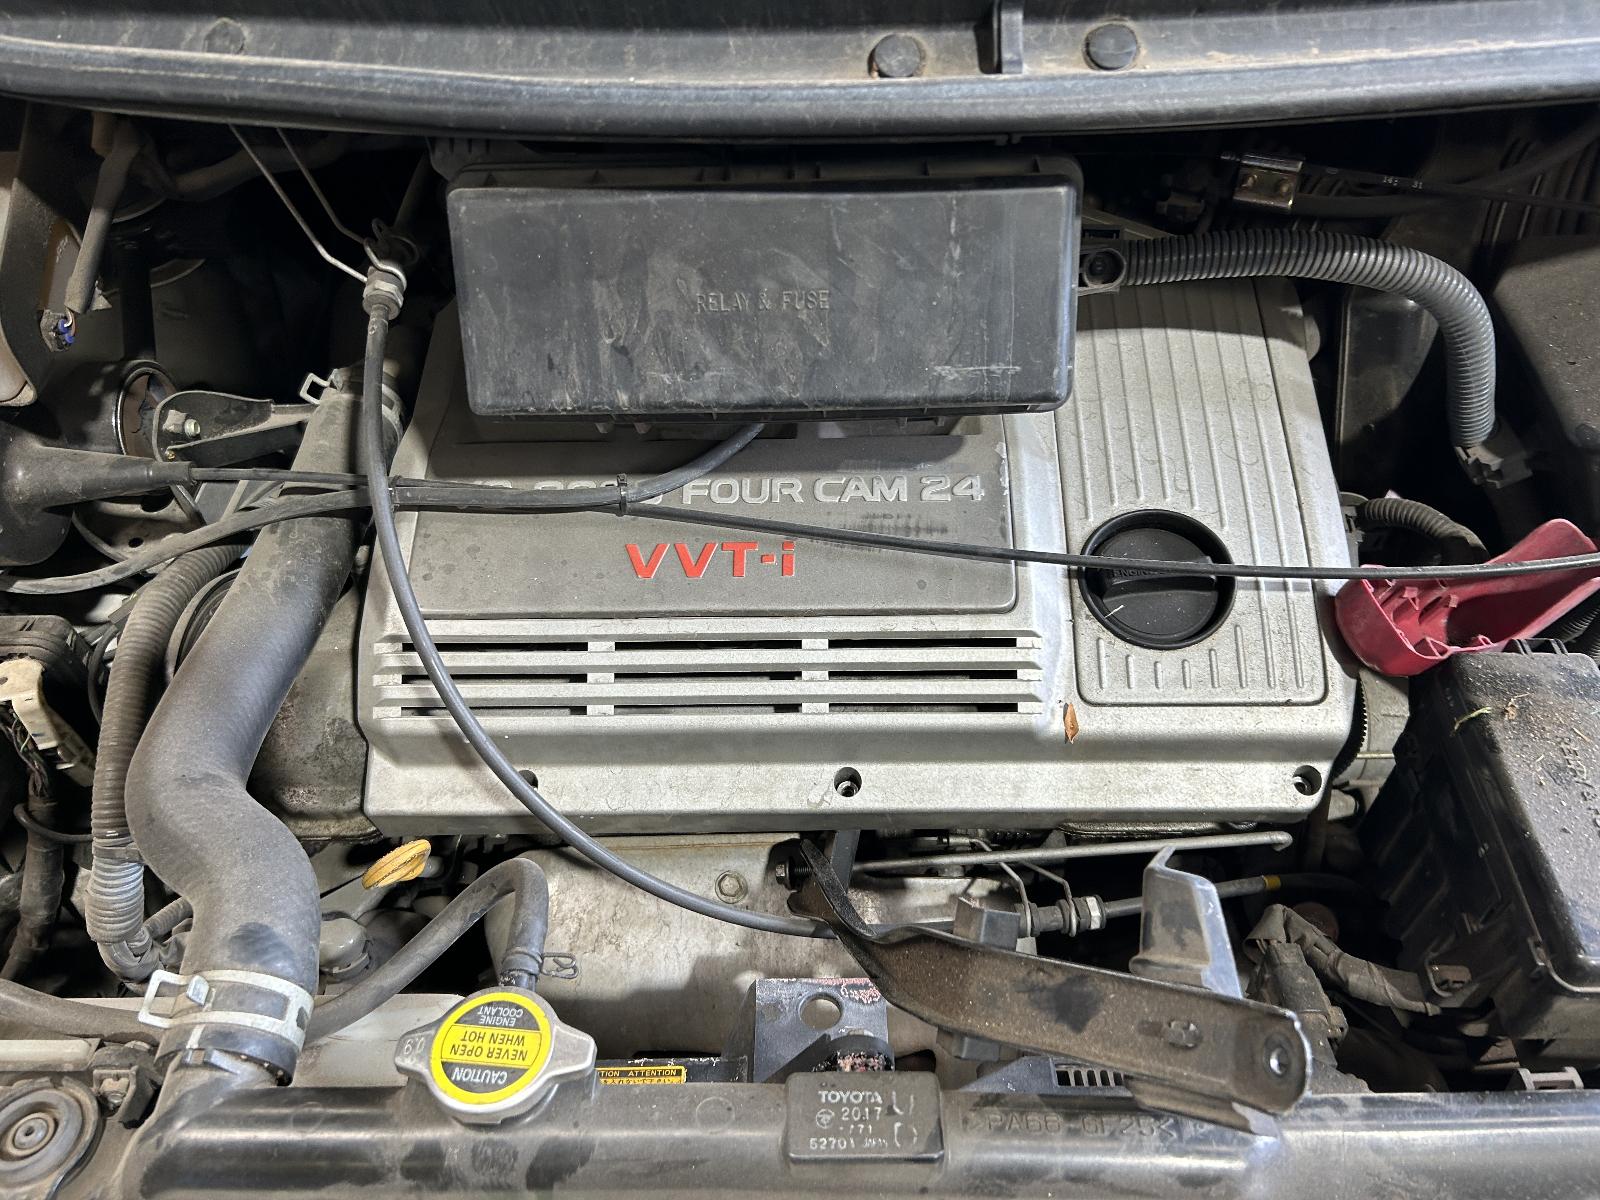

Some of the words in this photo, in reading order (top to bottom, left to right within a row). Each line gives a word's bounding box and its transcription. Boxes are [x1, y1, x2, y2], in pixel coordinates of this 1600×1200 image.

[694, 291, 750, 313] RELAY
[758, 289, 772, 311] &
[782, 289, 830, 311] FUSE
[681, 476, 804, 505] FOUR
[813, 474, 908, 502] CAM
[919, 474, 985, 502] 24
[624, 541, 796, 580] VVT-i
[477, 1005, 524, 1018] COOLANT
[479, 1015, 517, 1028] ENGINE
[460, 1030, 487, 1043] HOT
[488, 1032, 526, 1046] WHEN
[450, 1043, 483, 1057] OPEN
[486, 1046, 528, 1061] NEVER
[451, 1066, 508, 1084] CAUTION
[628, 1069, 677, 1077] ATTENTION
[818, 1090, 883, 1104] TOYOTA
